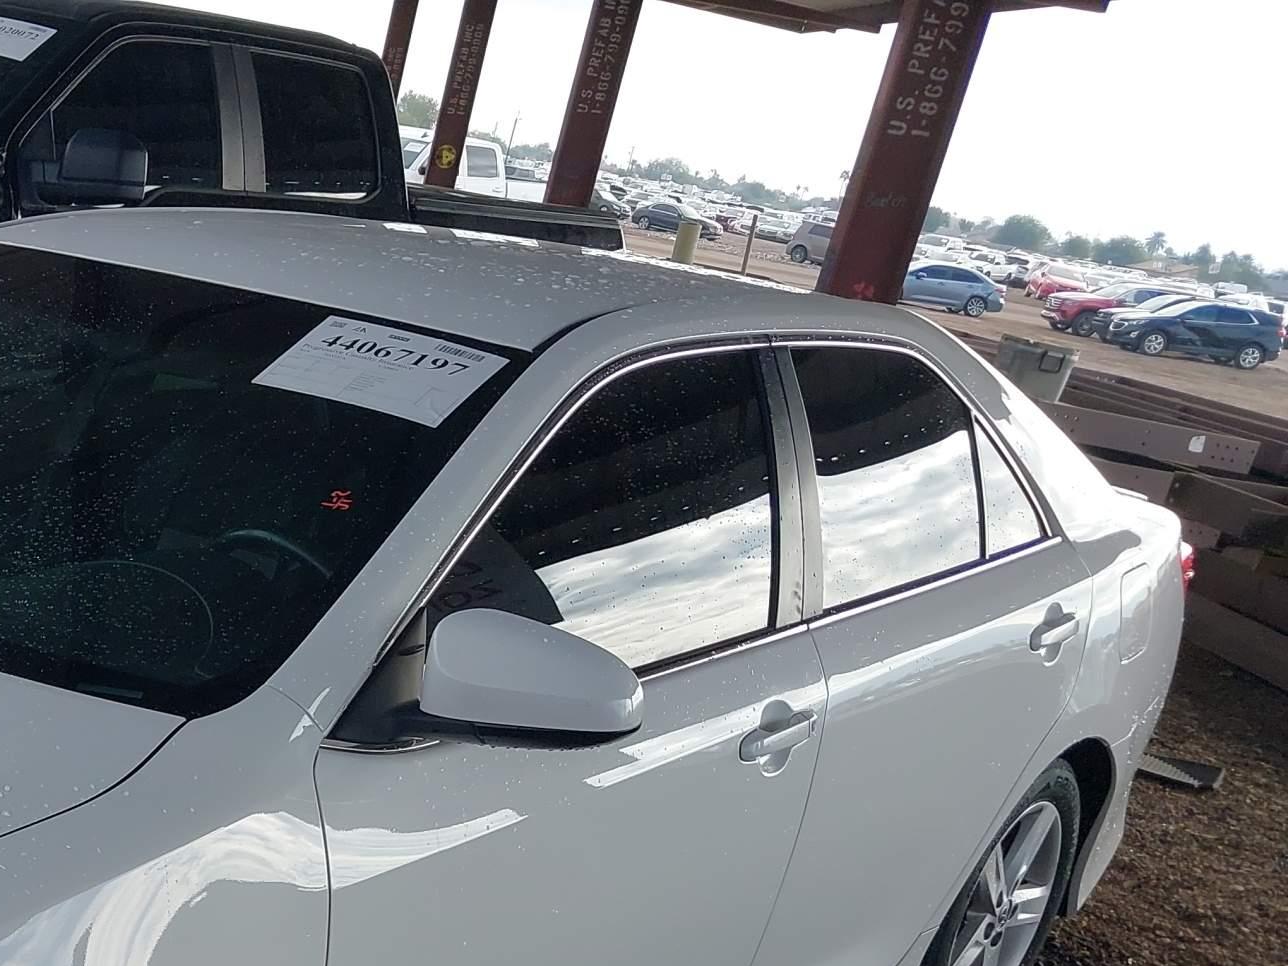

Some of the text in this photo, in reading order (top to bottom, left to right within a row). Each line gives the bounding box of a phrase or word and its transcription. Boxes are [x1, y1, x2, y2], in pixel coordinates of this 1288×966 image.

[587, 17, 612, 77] PREFAB
[888, 89, 920, 136] U.S.
[320, 335, 471, 377] 44067197
